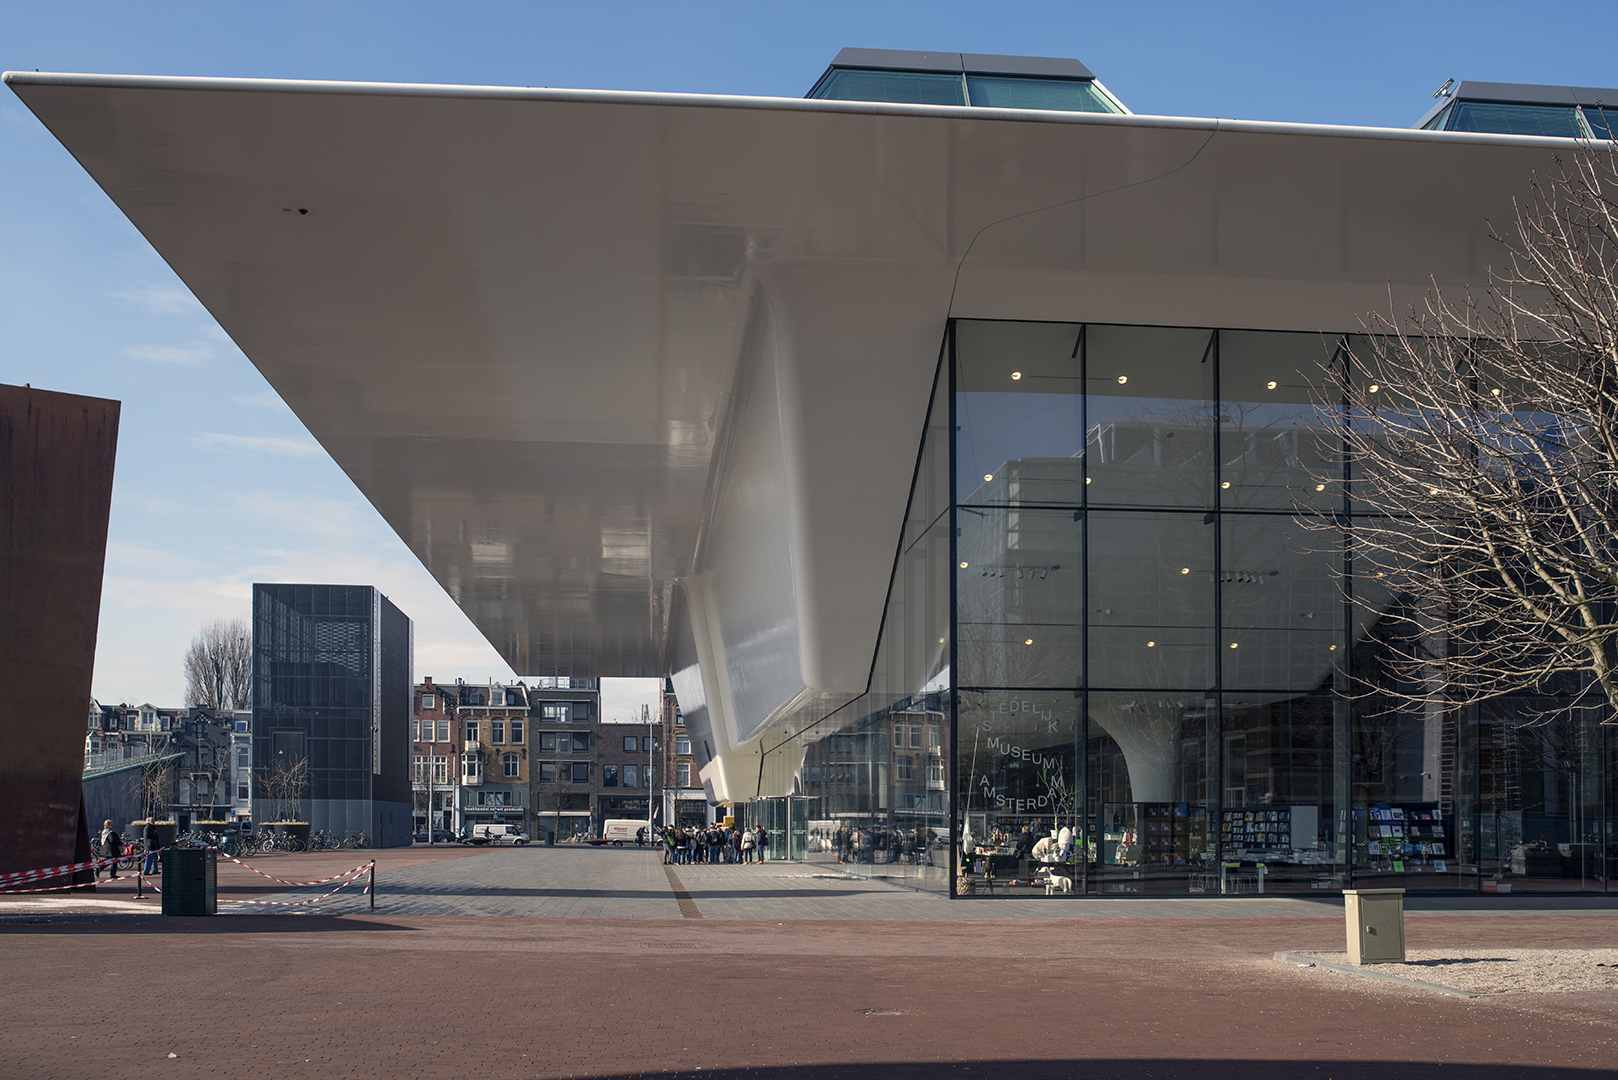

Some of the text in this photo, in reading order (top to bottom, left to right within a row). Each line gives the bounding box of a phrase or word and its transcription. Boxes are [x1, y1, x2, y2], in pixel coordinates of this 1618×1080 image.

[982, 700, 1058, 732] STEDELIJK
[987, 737, 1055, 769] MUSEUM
[979, 774, 1063, 811] AMSTERDAM
